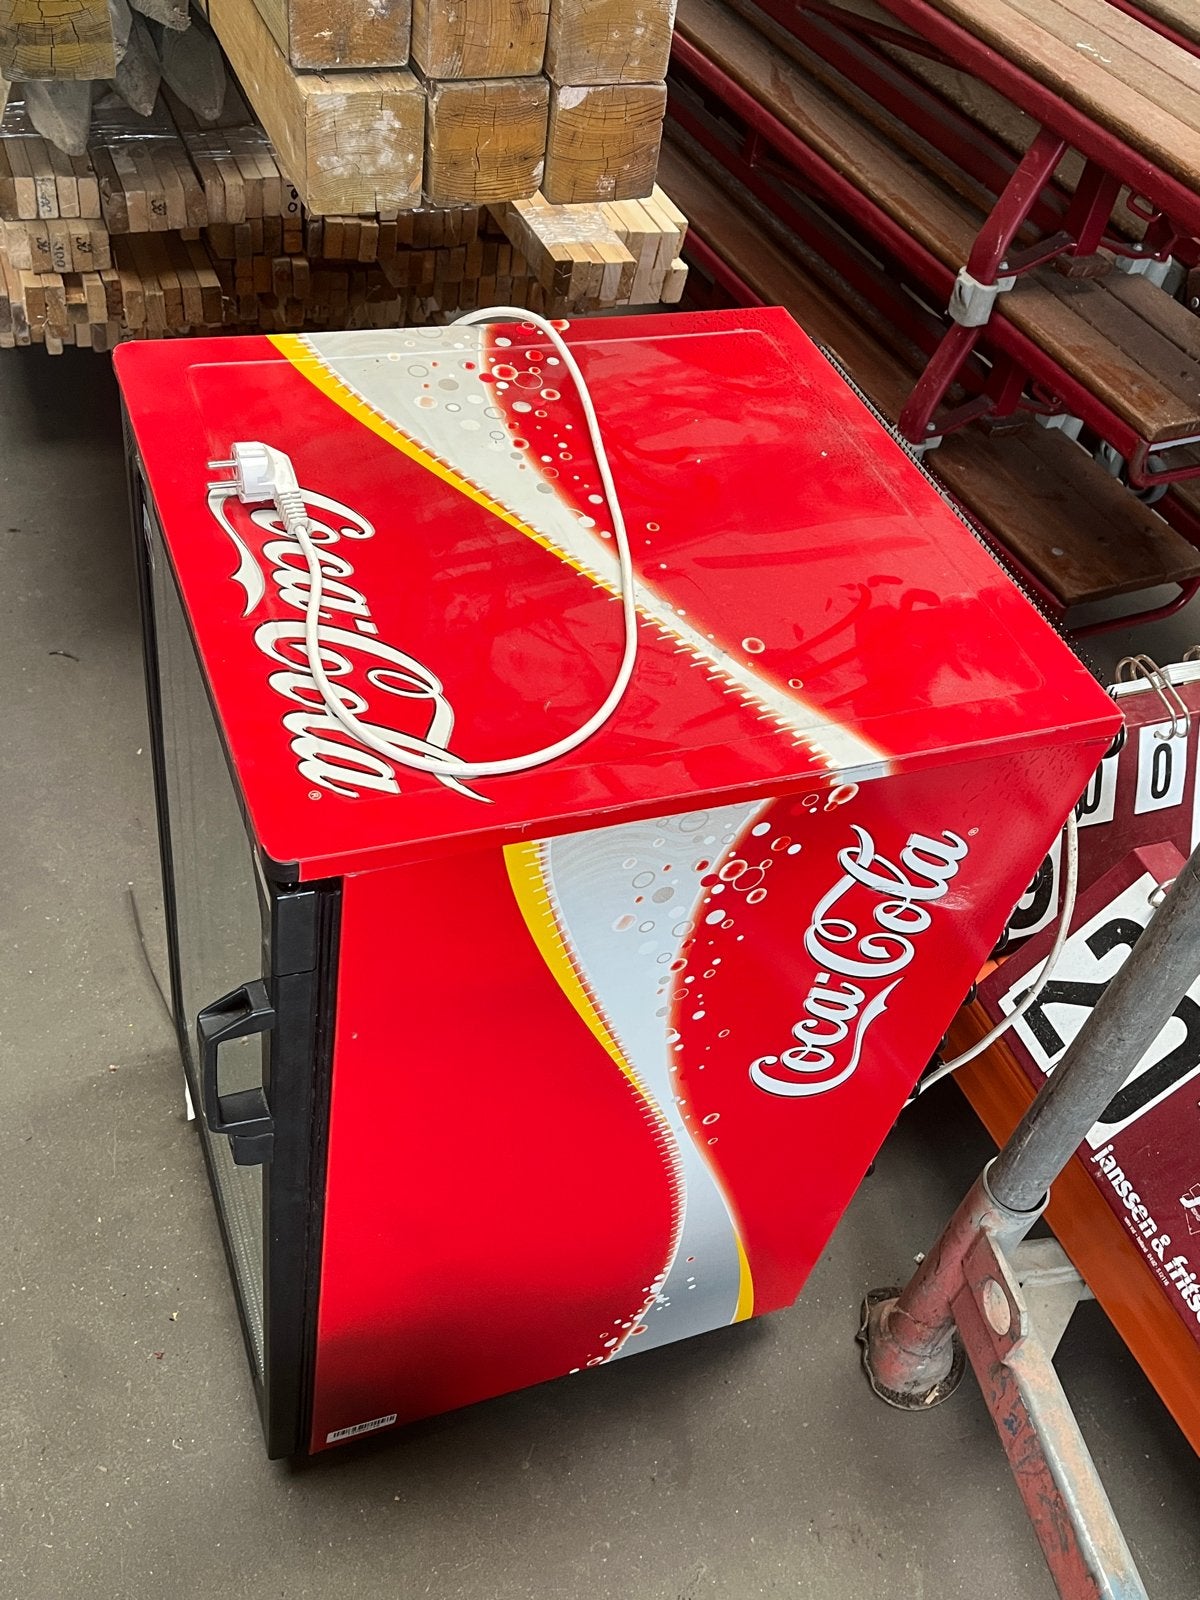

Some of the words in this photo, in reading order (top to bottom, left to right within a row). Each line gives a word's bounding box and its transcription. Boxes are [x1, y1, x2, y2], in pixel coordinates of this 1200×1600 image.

[748, 823, 969, 1098] Coca-Cola
[1090, 1144, 1158, 1239] janssen
[1150, 1234, 1171, 1263] &
[1163, 1255, 1200, 1325] frits
